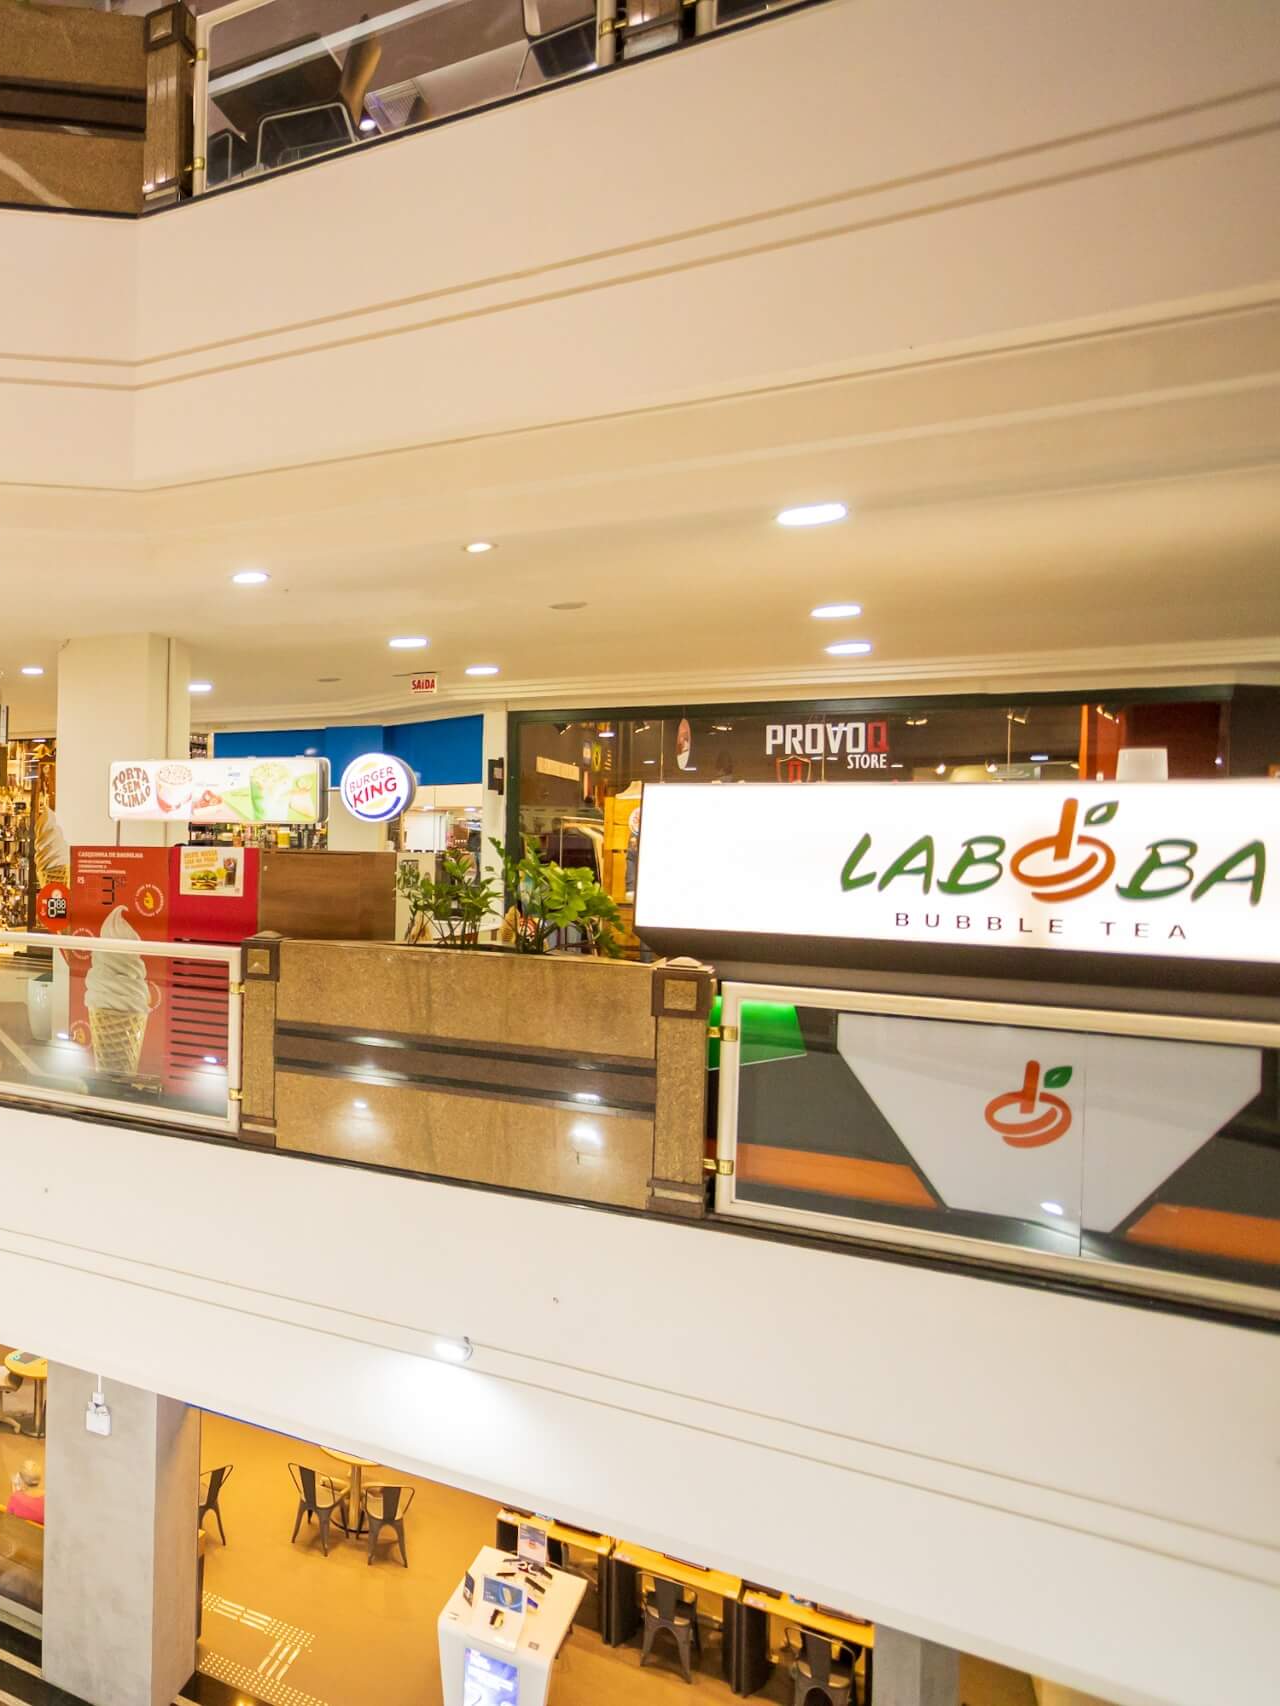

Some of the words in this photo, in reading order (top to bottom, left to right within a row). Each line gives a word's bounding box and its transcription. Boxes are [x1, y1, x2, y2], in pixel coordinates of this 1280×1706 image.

[765, 721, 889, 755] PROVOQ
[847, 754, 887, 769] STORE
[112, 767, 149, 791] TORTA
[349, 766, 394, 793] BURGER
[352, 777, 398, 808] KING
[840, 797, 1266, 907] LABOBA
[895, 912, 1064, 934] BUBBLE
[1100, 921, 1187, 939] TEA
